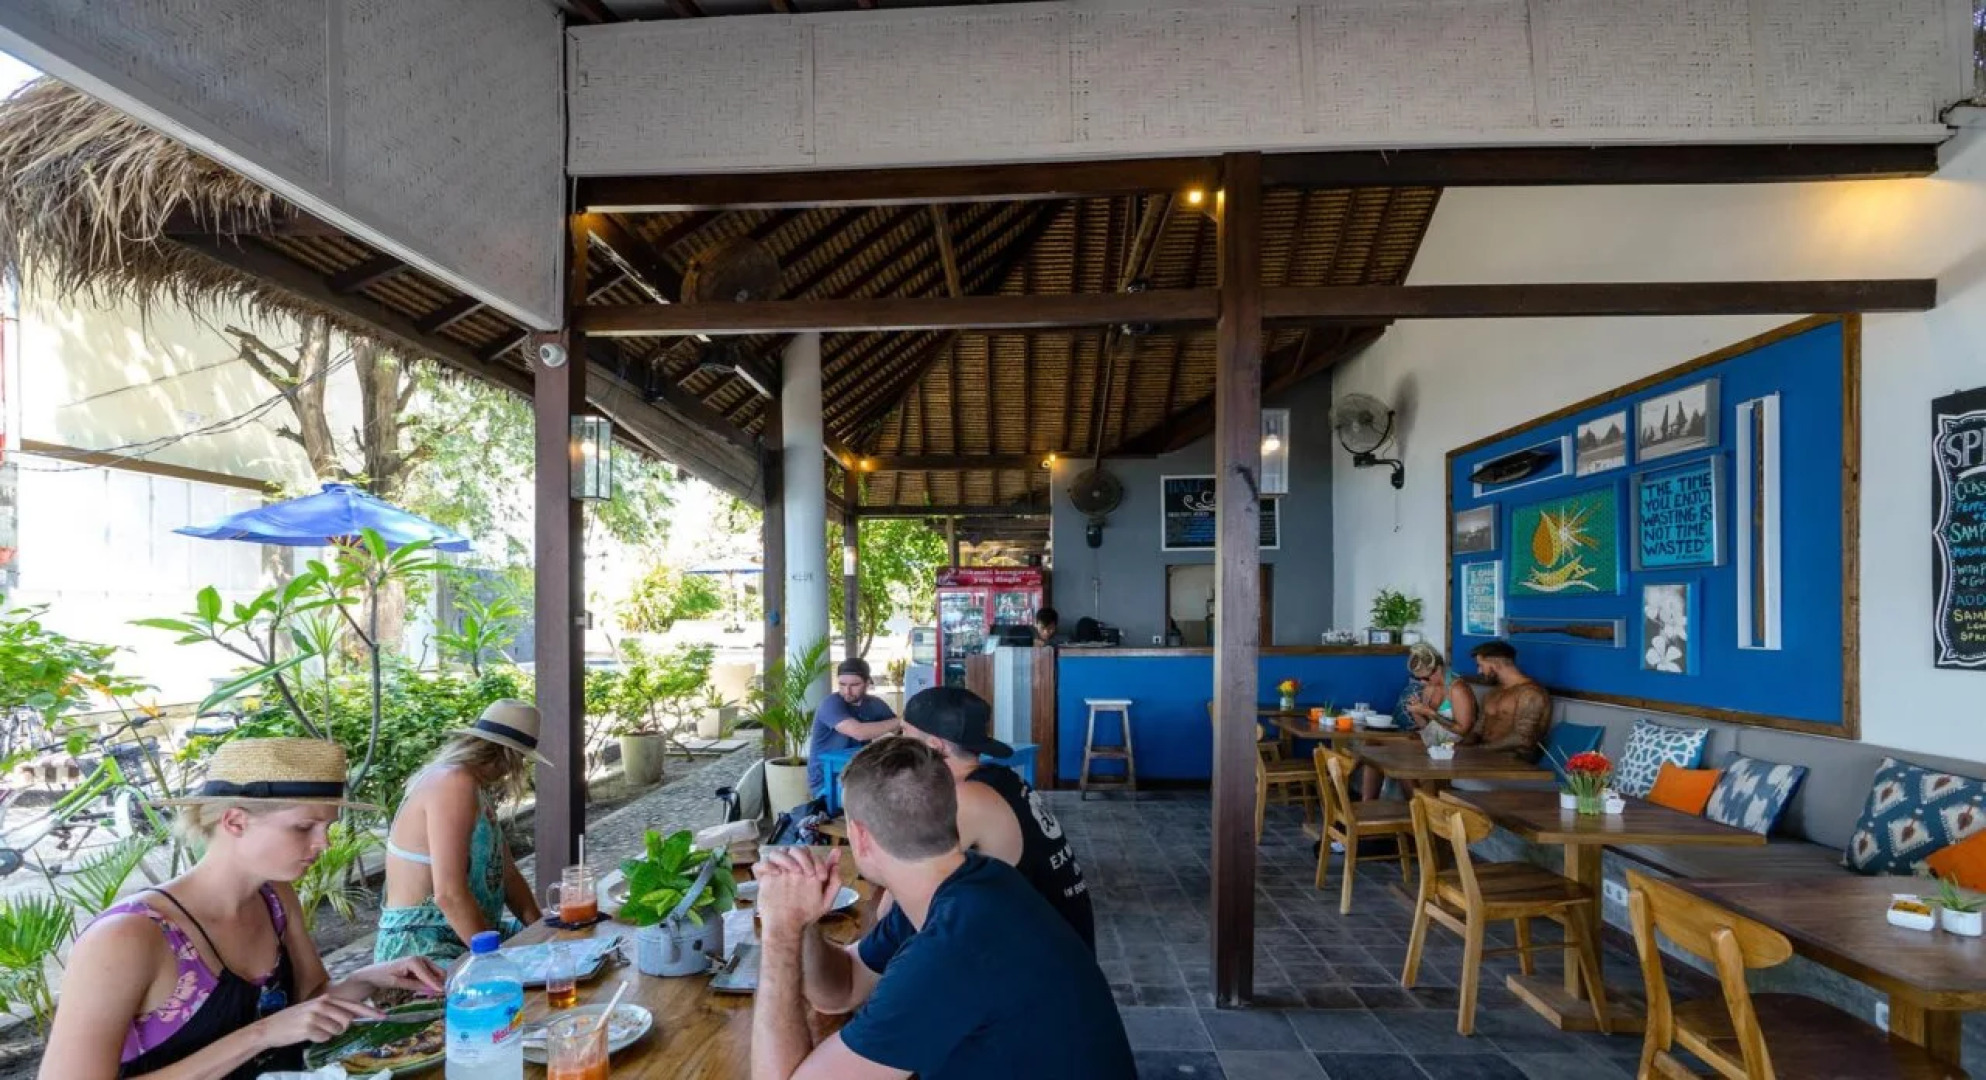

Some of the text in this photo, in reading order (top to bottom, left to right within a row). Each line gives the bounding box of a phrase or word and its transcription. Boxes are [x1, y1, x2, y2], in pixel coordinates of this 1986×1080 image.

[1645, 472, 1711, 498] THE TIME
[1645, 488, 1712, 511] YOU ENJOY
[1642, 503, 1712, 528] WASTING IS
[1644, 522, 1706, 543] NOT TIME
